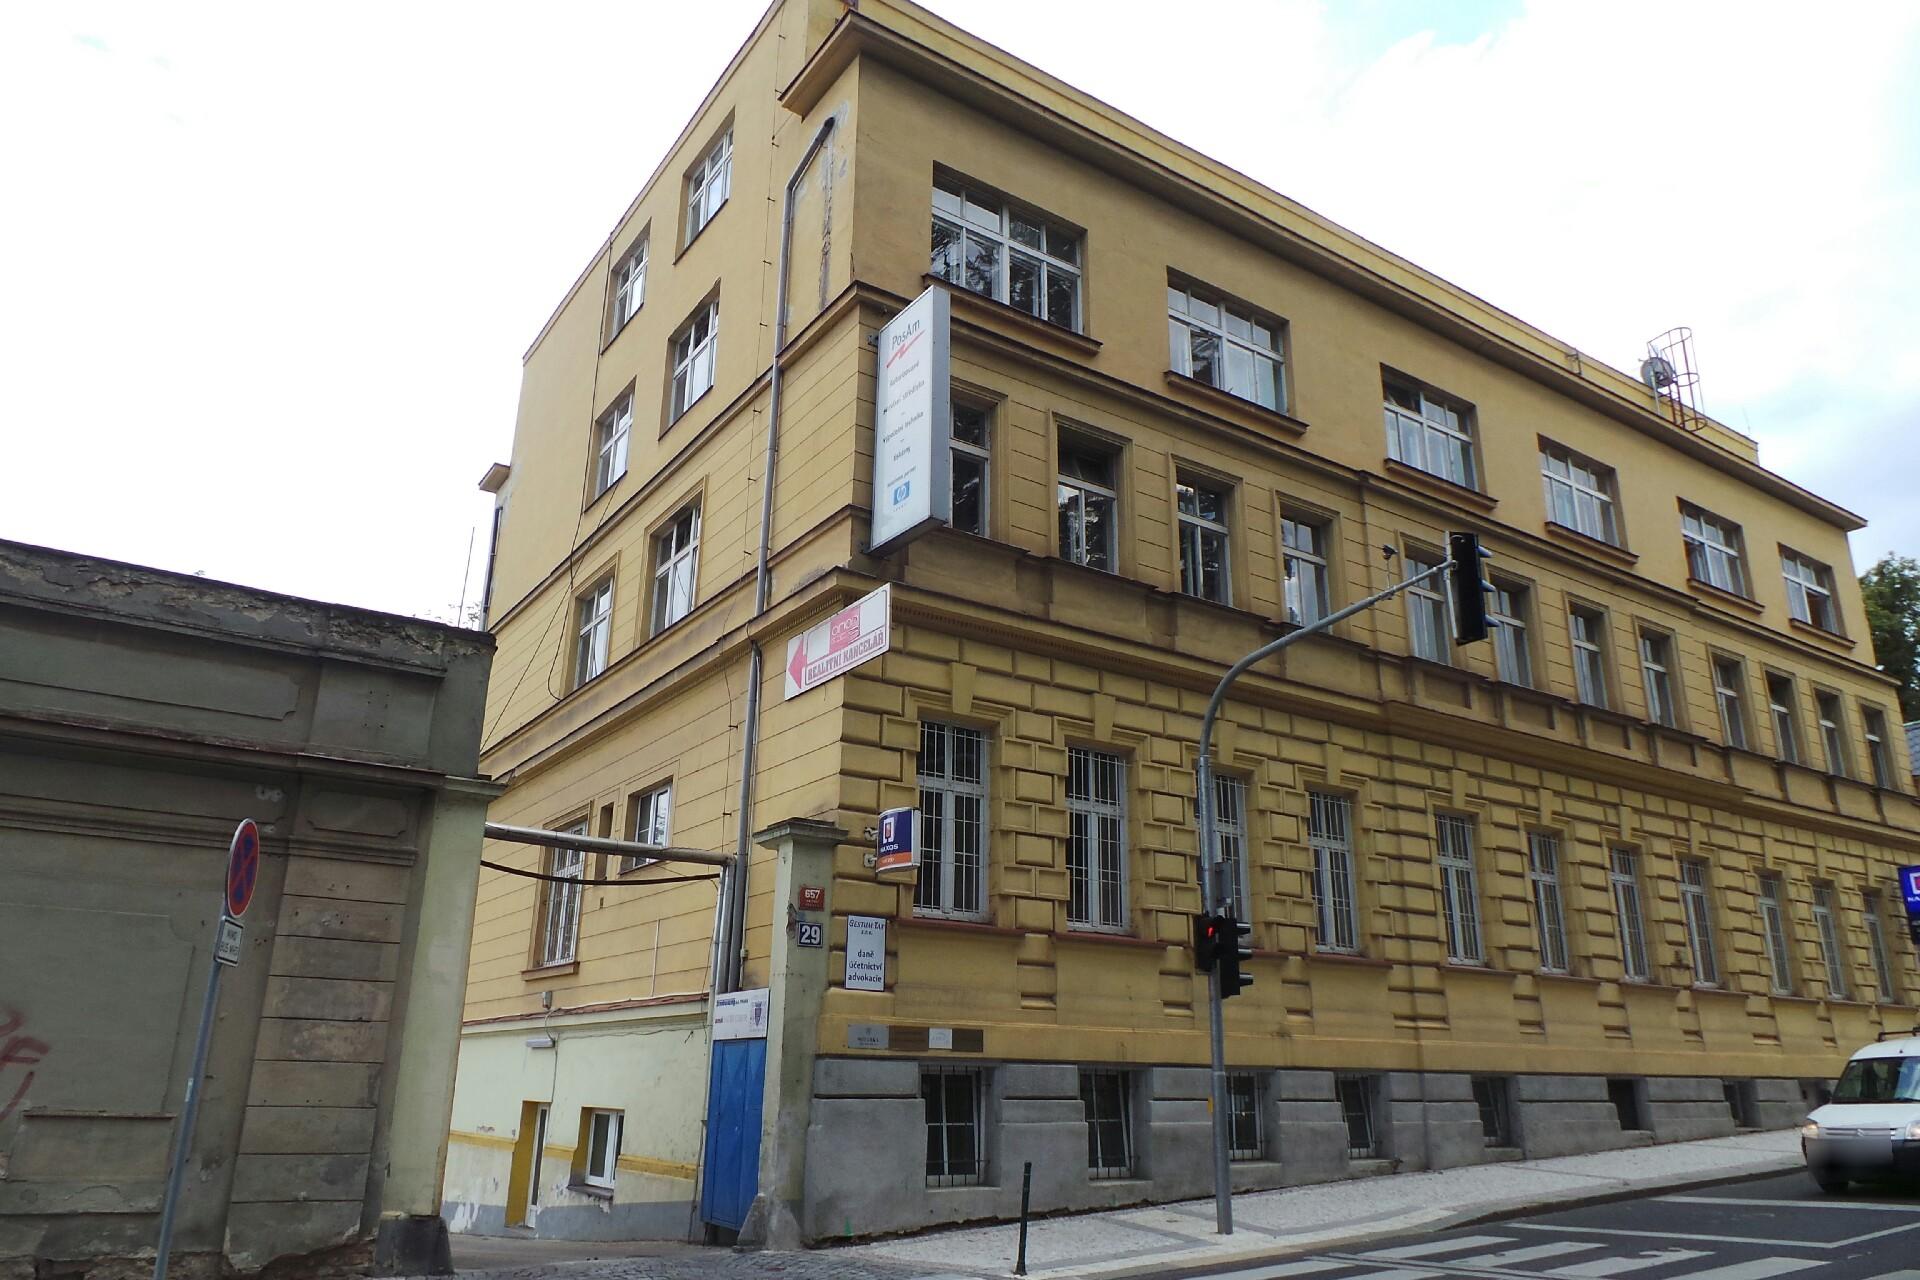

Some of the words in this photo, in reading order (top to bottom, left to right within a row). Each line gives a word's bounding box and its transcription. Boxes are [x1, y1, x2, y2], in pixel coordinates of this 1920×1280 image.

[892, 319, 920, 350] PosAm
[805, 890, 820, 900] 657
[801, 925, 820, 944] 29
[857, 949, 875, 958] daně
[849, 960, 882, 971] účetnictví
[848, 972, 882, 983] advokacie
